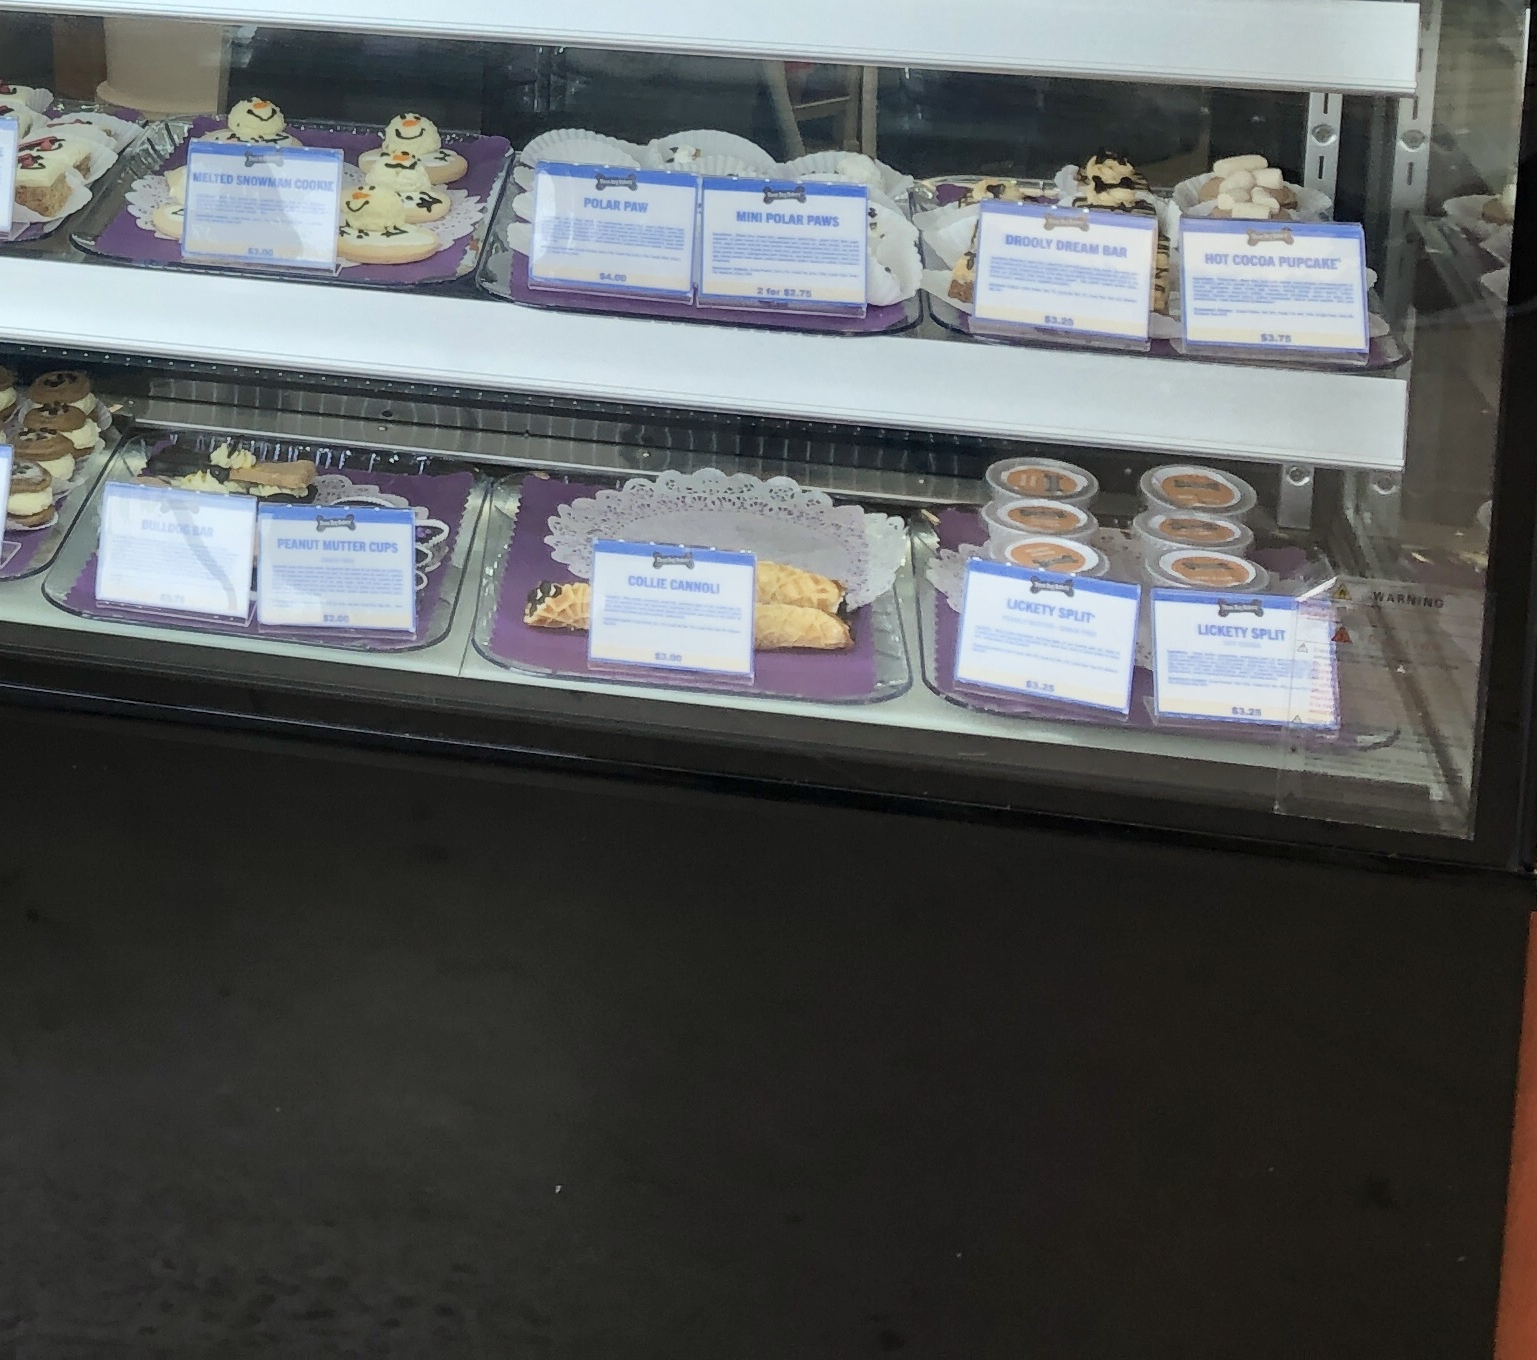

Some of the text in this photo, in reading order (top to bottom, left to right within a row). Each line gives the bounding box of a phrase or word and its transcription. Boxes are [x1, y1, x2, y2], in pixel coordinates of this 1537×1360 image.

[193, 172, 334, 191] MELTED SNOWMAN COOKIE
[584, 197, 648, 213] POLAR PAW
[736, 211, 840, 227] MINI POLAR PAWS
[1005, 234, 1127, 258] DROOLY DREAM BAR
[1205, 253, 1229, 265] HOT
[1233, 254, 1276, 267] COCOA
[766, 287, 779, 296] for
[278, 538, 398, 554] PEANUT MUTTER CUPS
[628, 575, 720, 594] COLLIE CANNOLI
[1007, 599, 1056, 616] LICKETY
[1373, 591, 1444, 608] WARNING
[1198, 624, 1286, 641] LICKETY SPLIT
